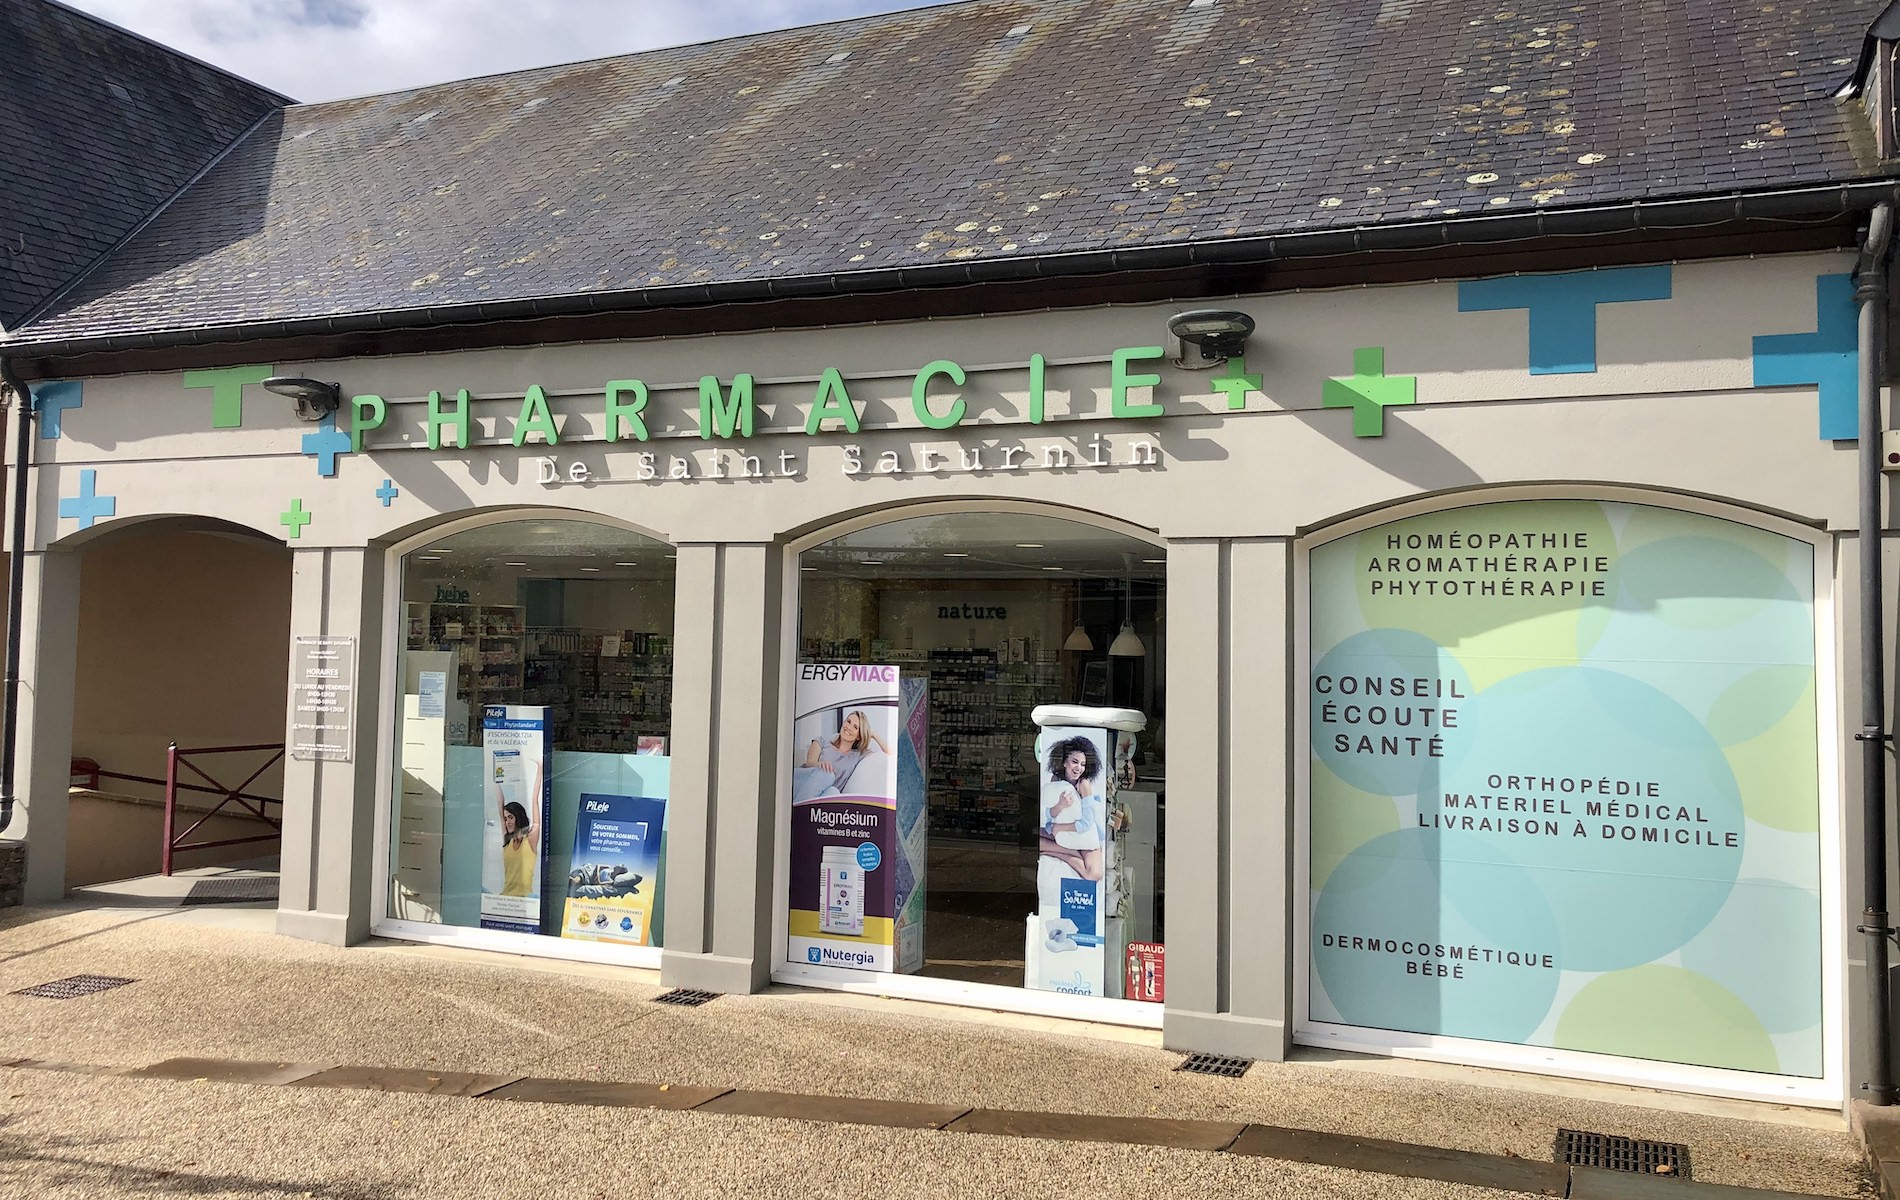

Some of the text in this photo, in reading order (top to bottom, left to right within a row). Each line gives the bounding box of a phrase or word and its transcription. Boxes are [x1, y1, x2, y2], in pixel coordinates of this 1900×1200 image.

[351, 345, 1165, 453] PHARMACIE
[536, 432, 1157, 484] De Saint Saturnin
[1386, 531, 1589, 551] HOMÉOPATHIE
[1367, 554, 1610, 574] AROMATHÉRAPIE
[1370, 577, 1607, 597] PHYTOTHÉRAPIE
[937, 603, 1007, 620] nature
[306, 668, 339, 676] HORAIRES
[1315, 675, 1465, 699] CONSEIL
[1321, 701, 1459, 728] ÉCOUTE
[1334, 733, 1445, 757] SANTÉ
[1487, 774, 1660, 797] ORTHOPÉDIE
[586, 801, 609, 813] PiLeJe
[810, 807, 878, 827] Magnésium
[1445, 793, 1708, 822] MATERIEL MÉDICAL
[817, 827, 845, 836] vitamines
[845, 828, 851, 837] B
[1419, 813, 1738, 848] LIVRAISON À DOMICILE
[603, 839, 631, 848] pharmacien
[823, 948, 874, 965] Nutergia
[1129, 943, 1164, 954] GIBAUD
[1323, 934, 1554, 968] DERMOCOSMÉTIQUE
[1406, 959, 1464, 979] BÉBÉ
